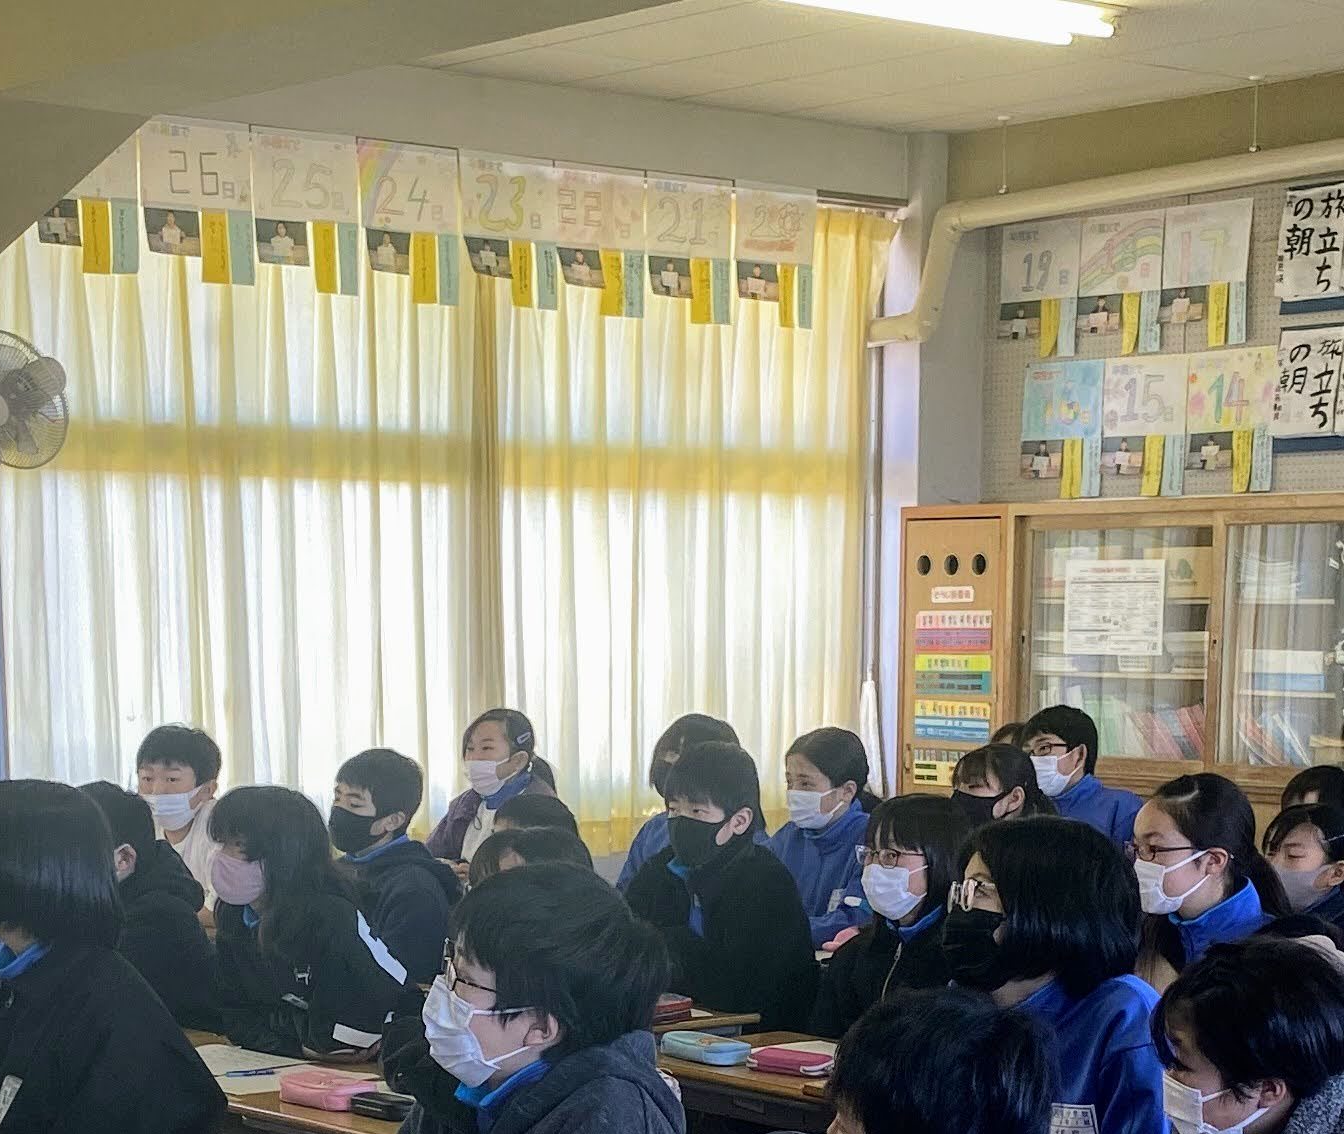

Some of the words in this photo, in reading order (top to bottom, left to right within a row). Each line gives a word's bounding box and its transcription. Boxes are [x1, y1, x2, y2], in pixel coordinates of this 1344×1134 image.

[168, 150, 218, 195] 26
[272, 158, 332, 211] 25
[375, 175, 428, 221] 24
[476, 174, 527, 232] 23
[657, 197, 707, 244] 21
[1283, 197, 1315, 260] の朝
[1022, 249, 1052, 292] 19
[1279, 343, 1311, 395] の朝
[1309, 338, 1343, 429] 旅立ち
[1121, 374, 1166, 423] 15
[1208, 371, 1249, 425] 14
